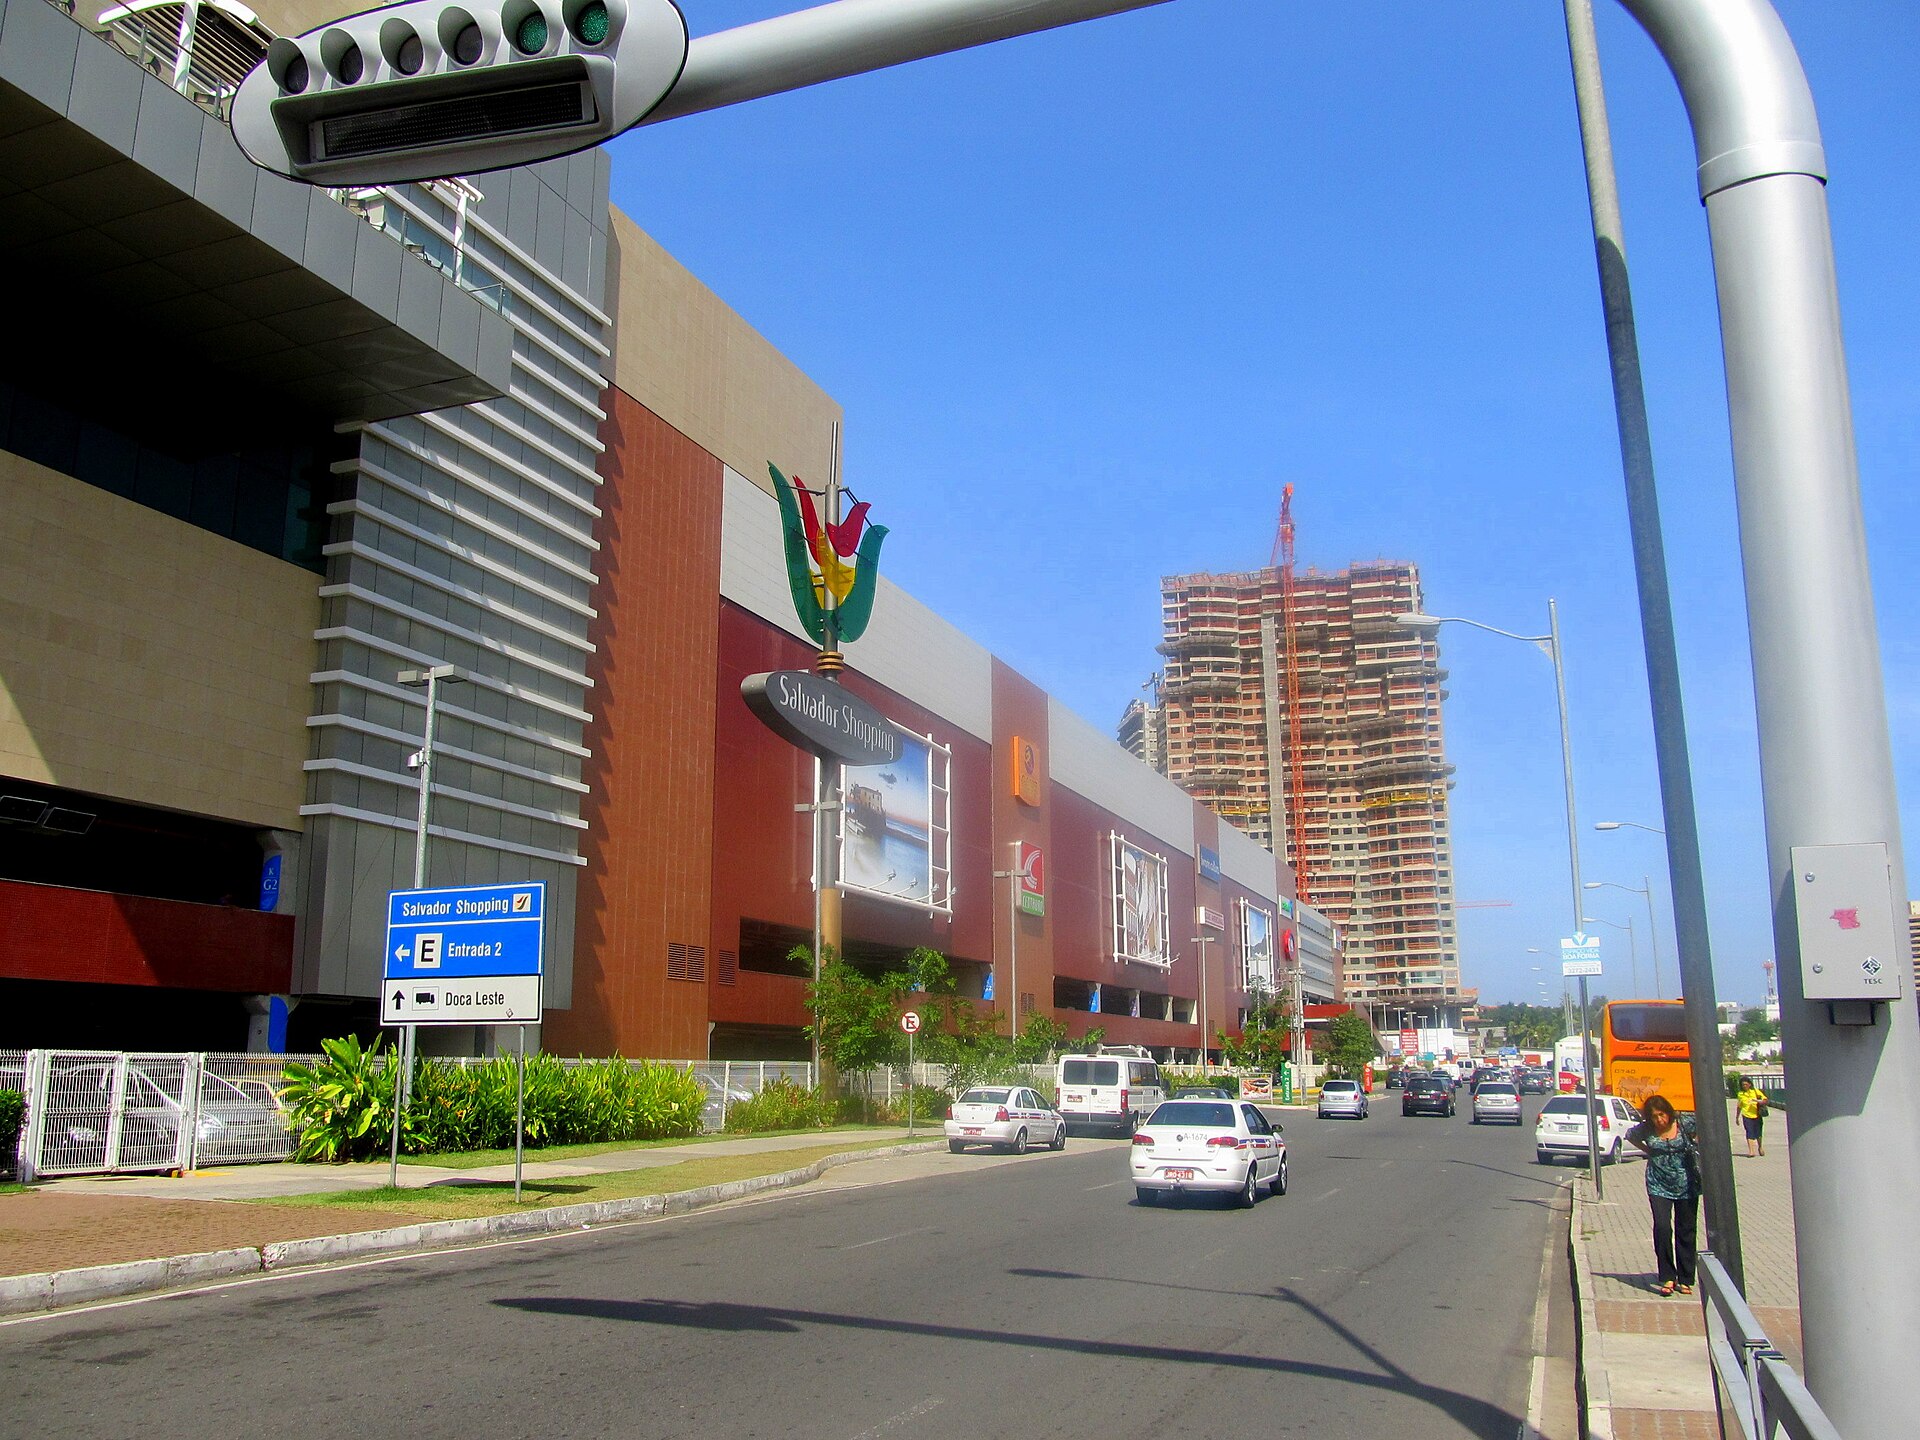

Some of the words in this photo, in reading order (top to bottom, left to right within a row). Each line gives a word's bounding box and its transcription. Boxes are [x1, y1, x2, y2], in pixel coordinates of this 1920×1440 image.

[780, 674, 839, 728] Salvador
[842, 705, 894, 760] Shopping
[263, 878, 278, 890] G2
[402, 901, 451, 917] Salvador
[456, 897, 509, 915] Shopping
[420, 939, 435, 963] E
[448, 942, 491, 957] Entrada
[494, 942, 502, 957] 2
[445, 992, 472, 1006] Doca
[476, 991, 505, 1005] Leste
